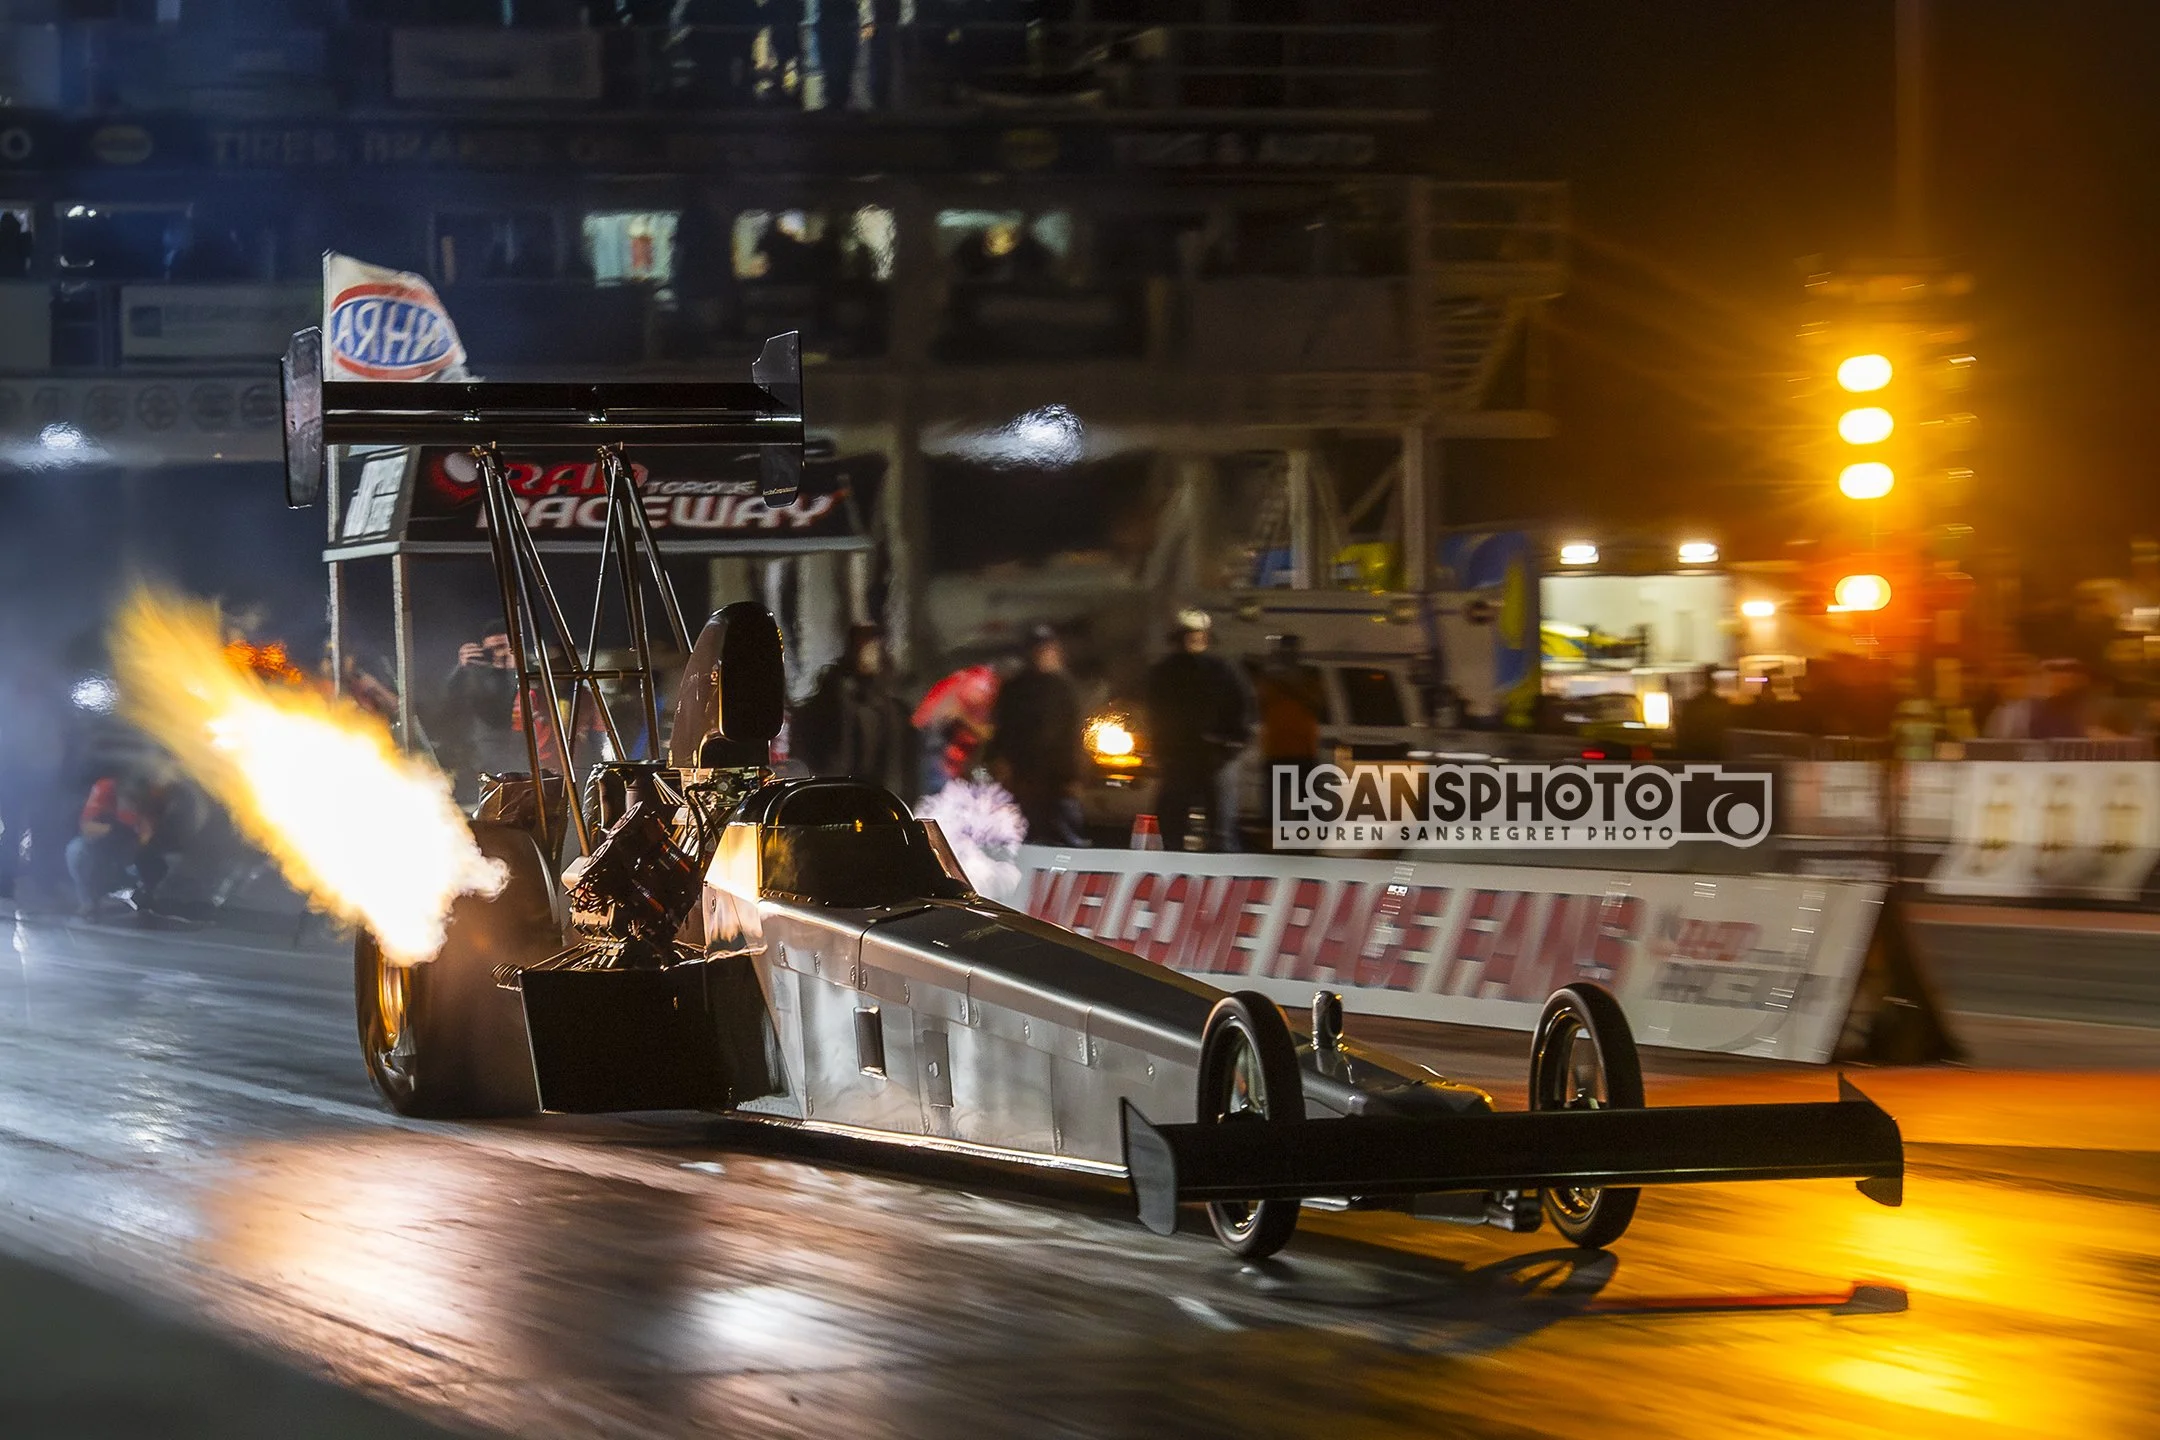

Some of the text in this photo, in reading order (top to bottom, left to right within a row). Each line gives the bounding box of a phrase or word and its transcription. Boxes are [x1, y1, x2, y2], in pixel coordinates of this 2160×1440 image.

[1025, 867, 1279, 976] WELCOME
[1260, 876, 1455, 994] RACE
[1450, 887, 1646, 1006] FANS
